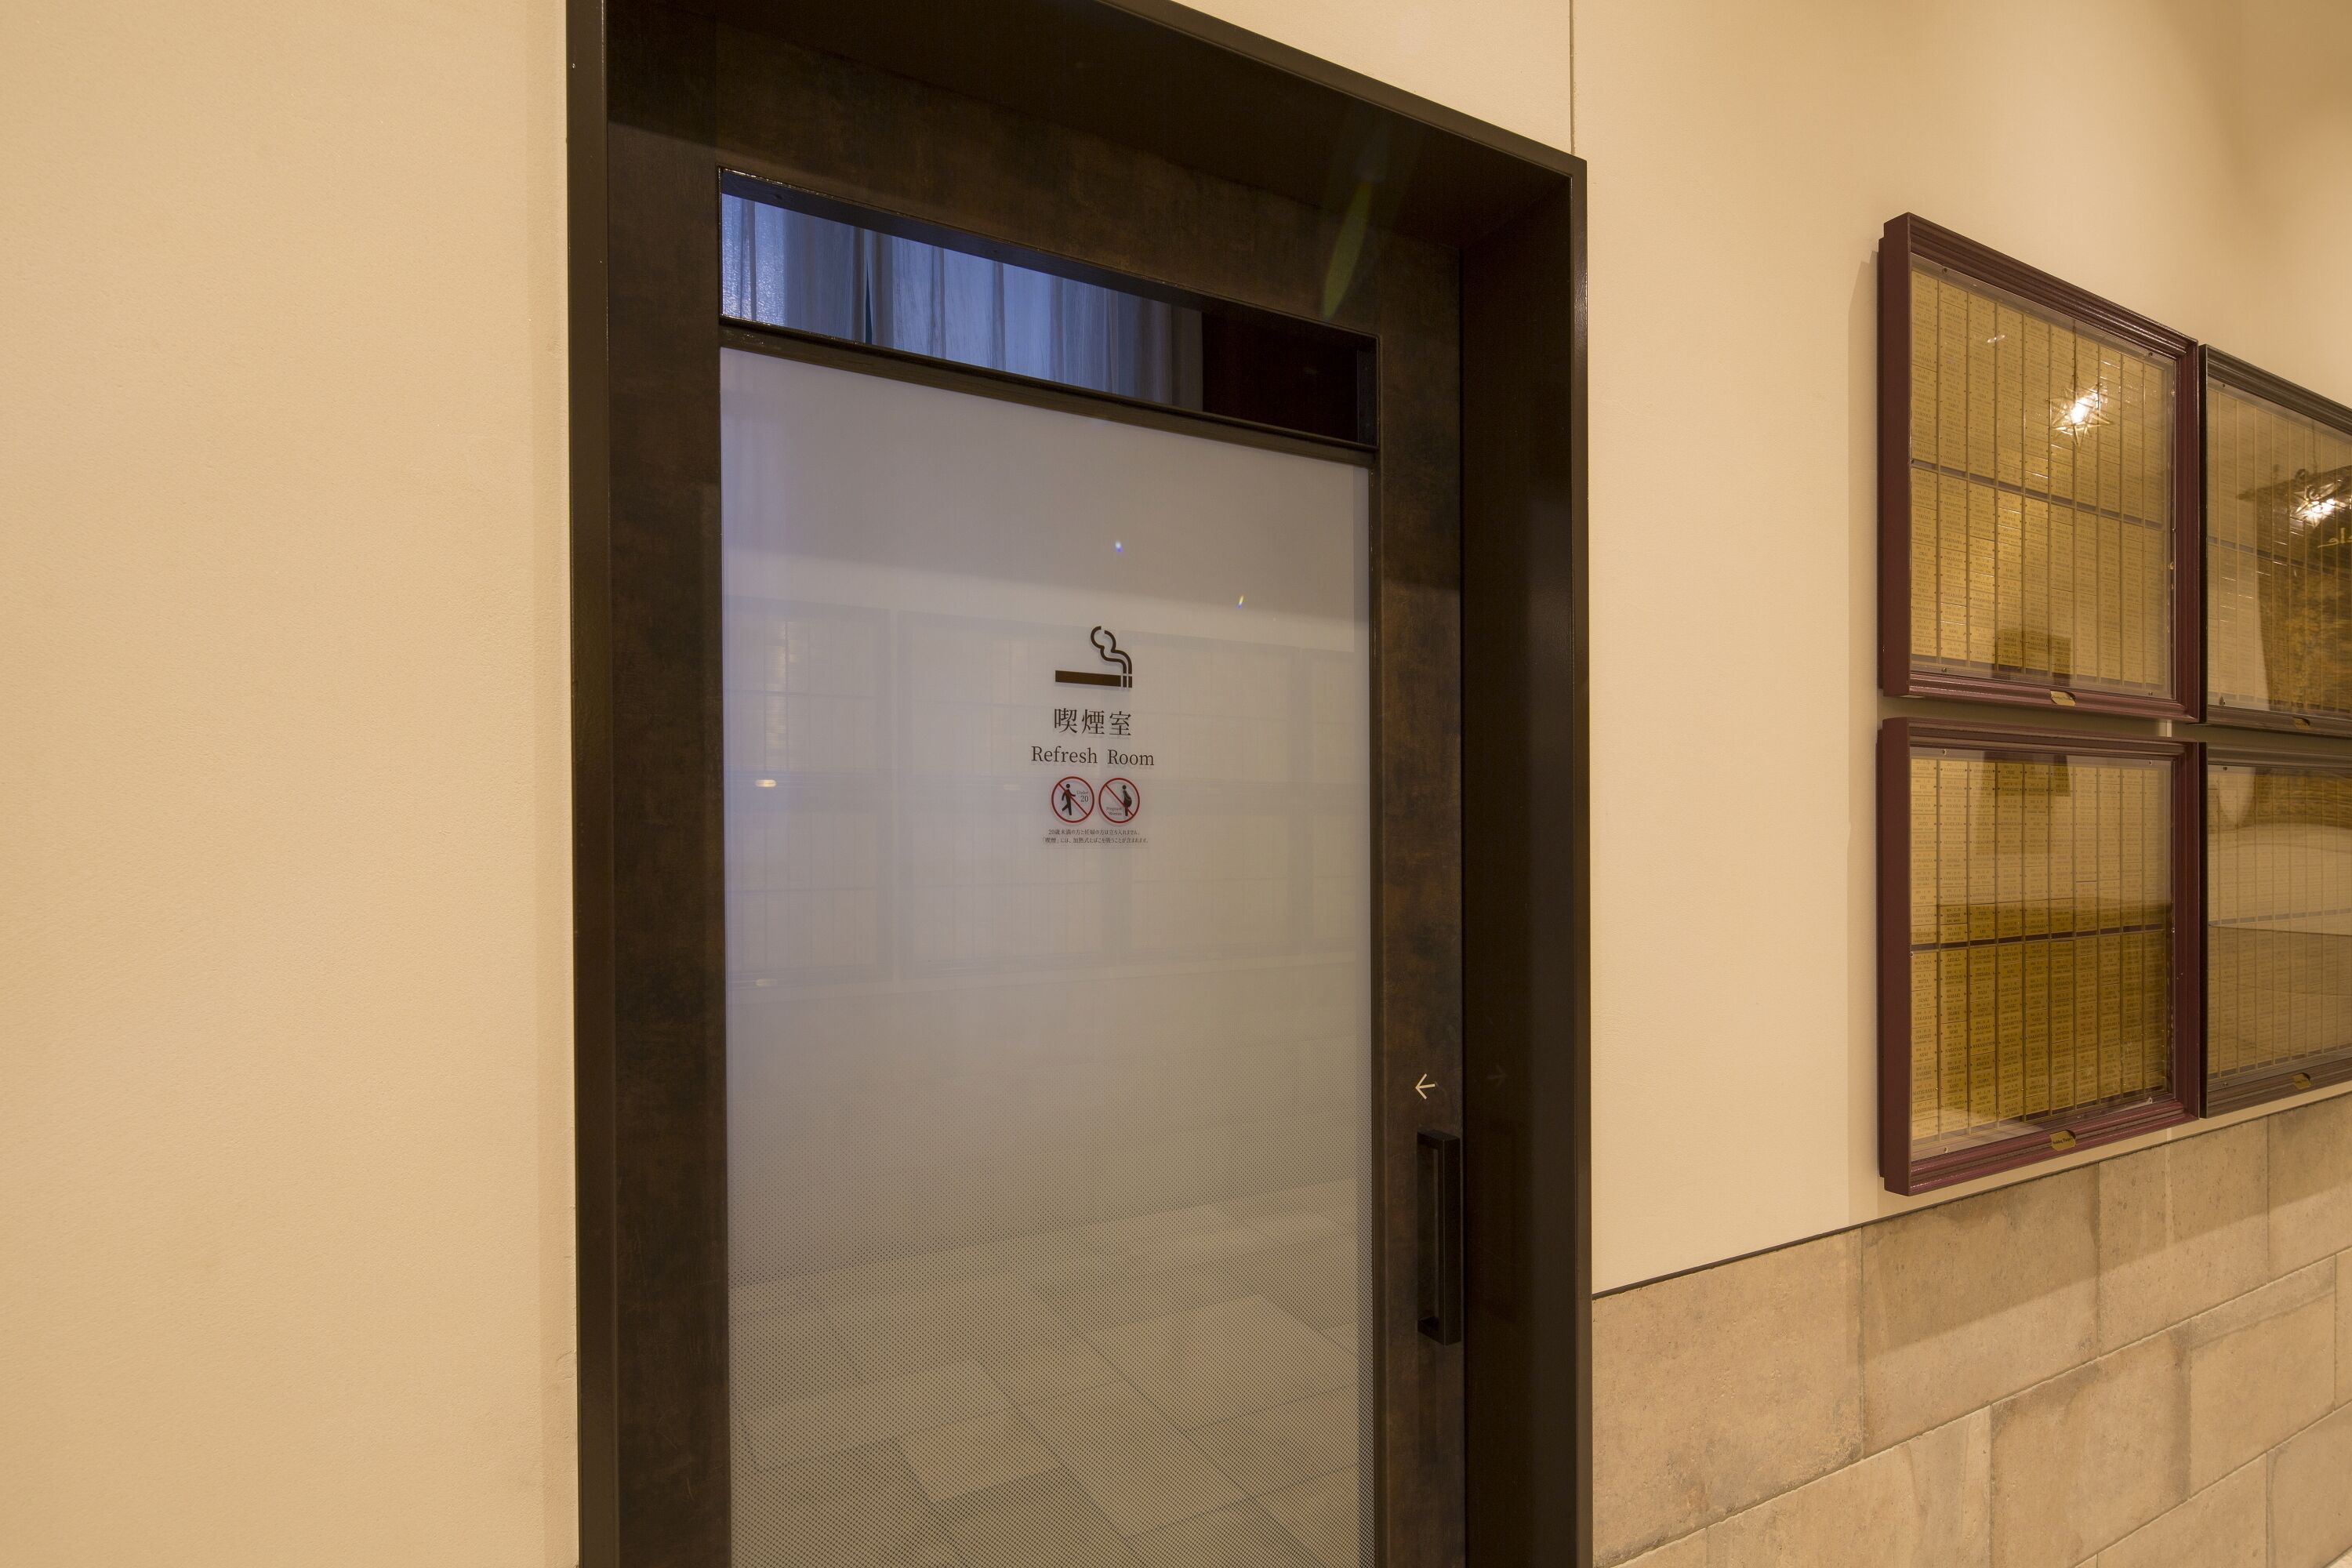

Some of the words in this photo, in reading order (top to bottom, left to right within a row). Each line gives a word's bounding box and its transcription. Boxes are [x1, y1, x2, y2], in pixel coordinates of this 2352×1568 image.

[1054, 708, 1131, 735] 喫煙室
[1031, 746, 1098, 764] Refresh
[1107, 749, 1154, 766] Room
